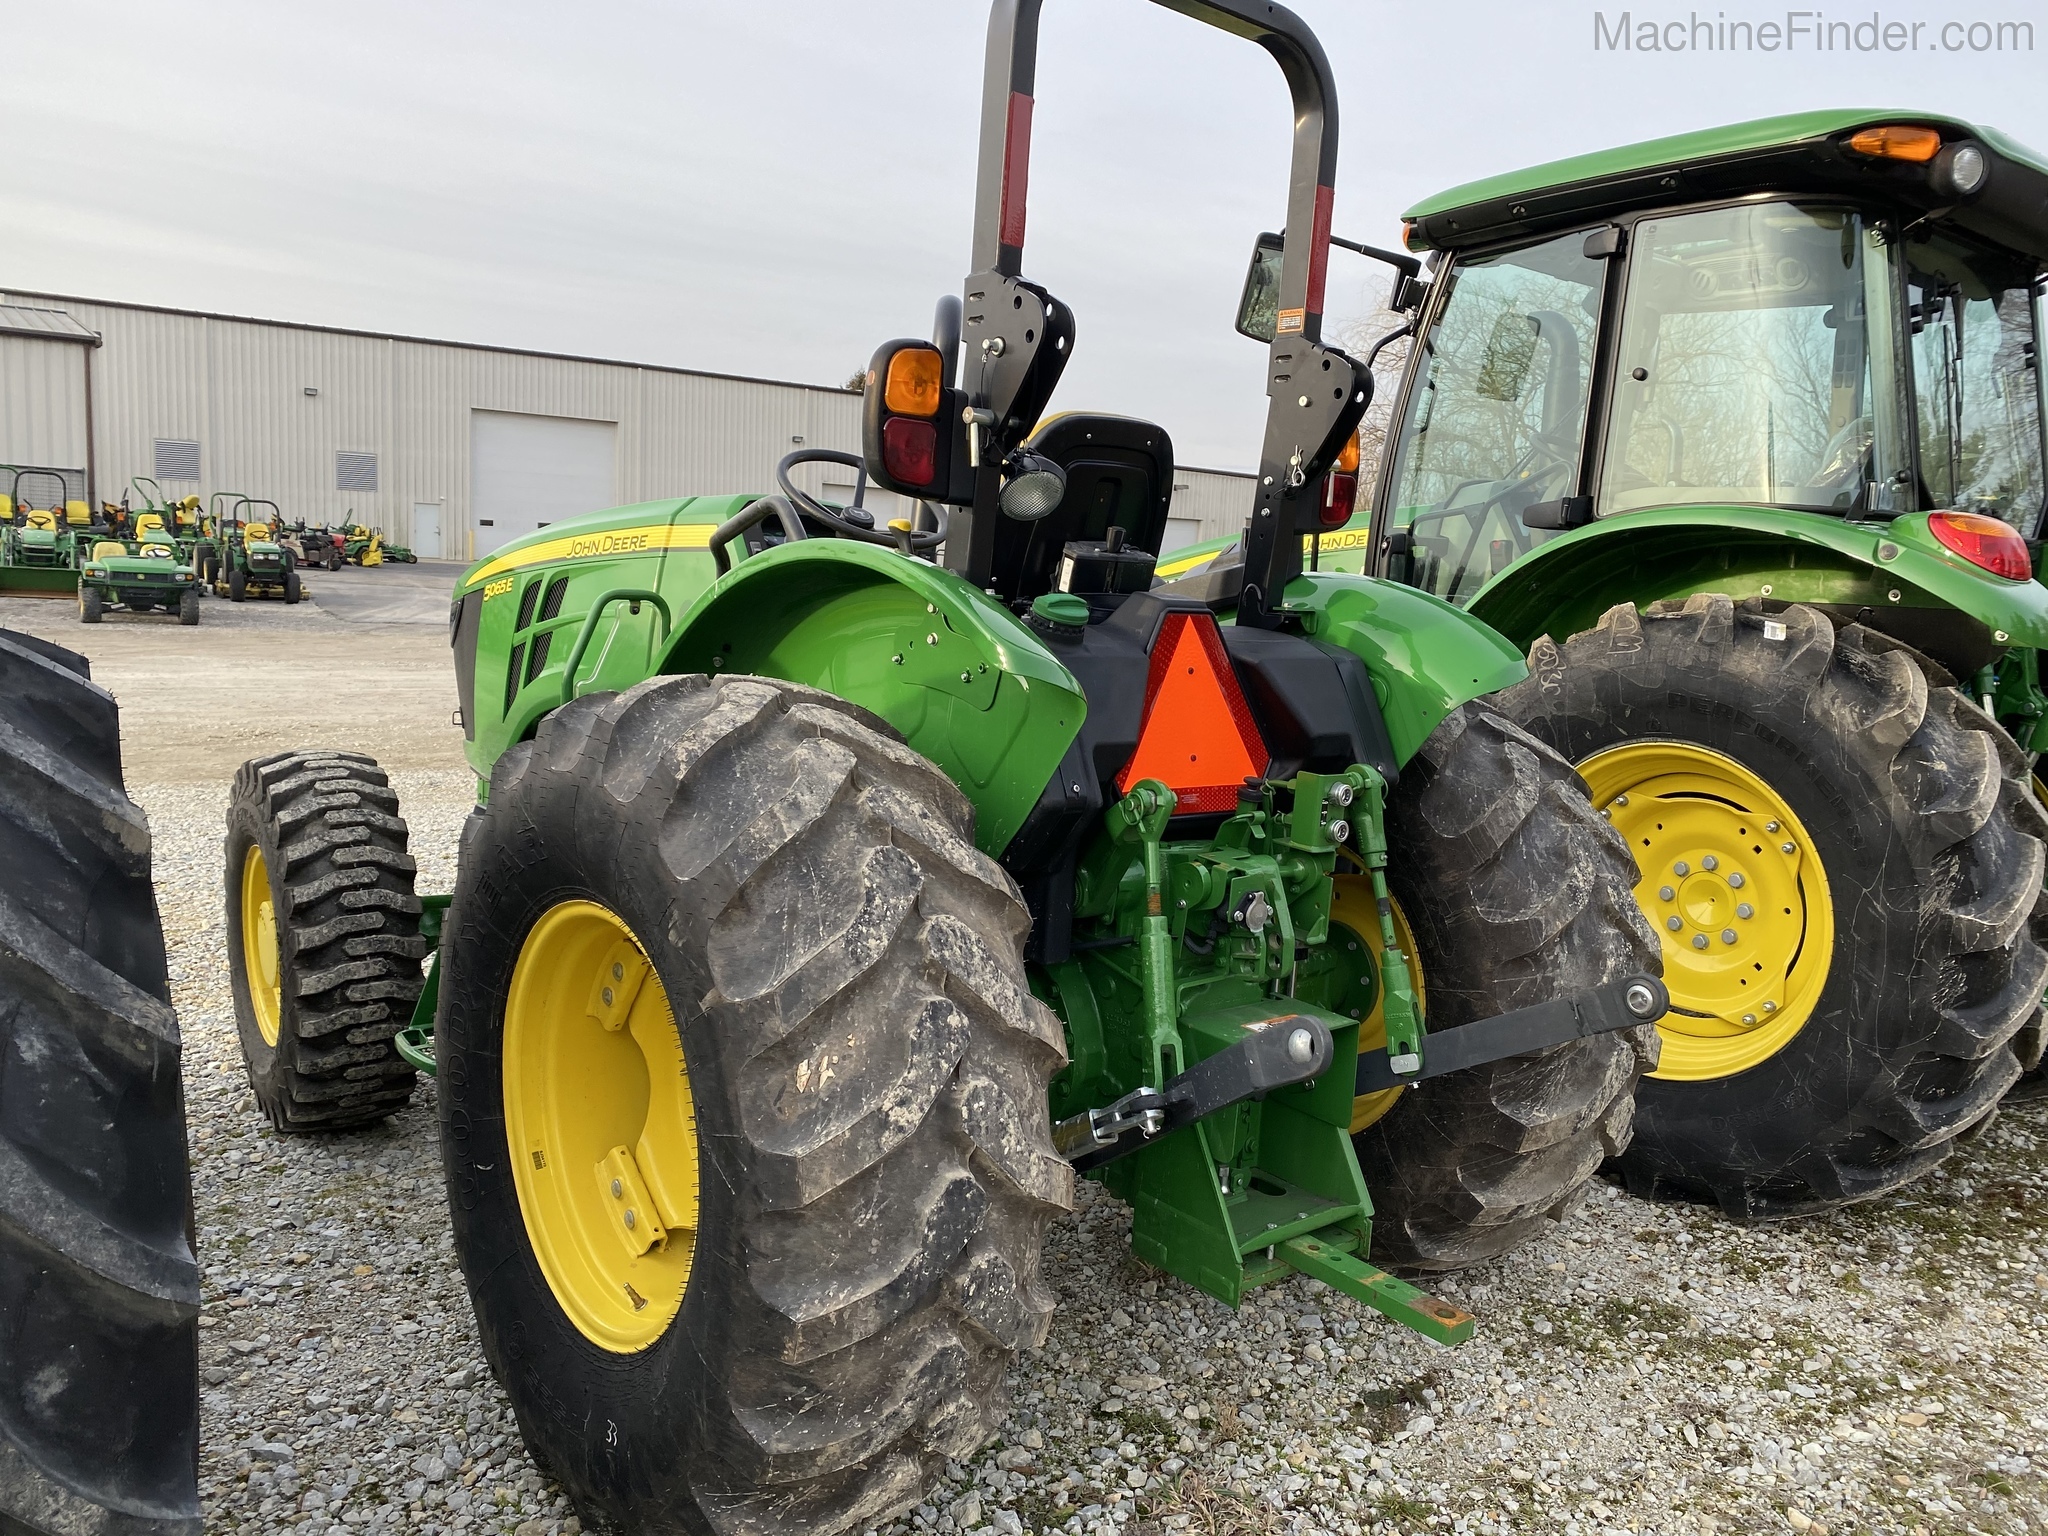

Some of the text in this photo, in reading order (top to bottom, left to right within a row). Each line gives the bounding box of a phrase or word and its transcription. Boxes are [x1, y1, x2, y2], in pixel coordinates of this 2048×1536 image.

[567, 535, 648, 557] JOHN DEERE
[1304, 533, 1366, 551] JHN DE
[484, 578, 514, 601] 5065E
[1666, 691, 1852, 818] PERFORMER
